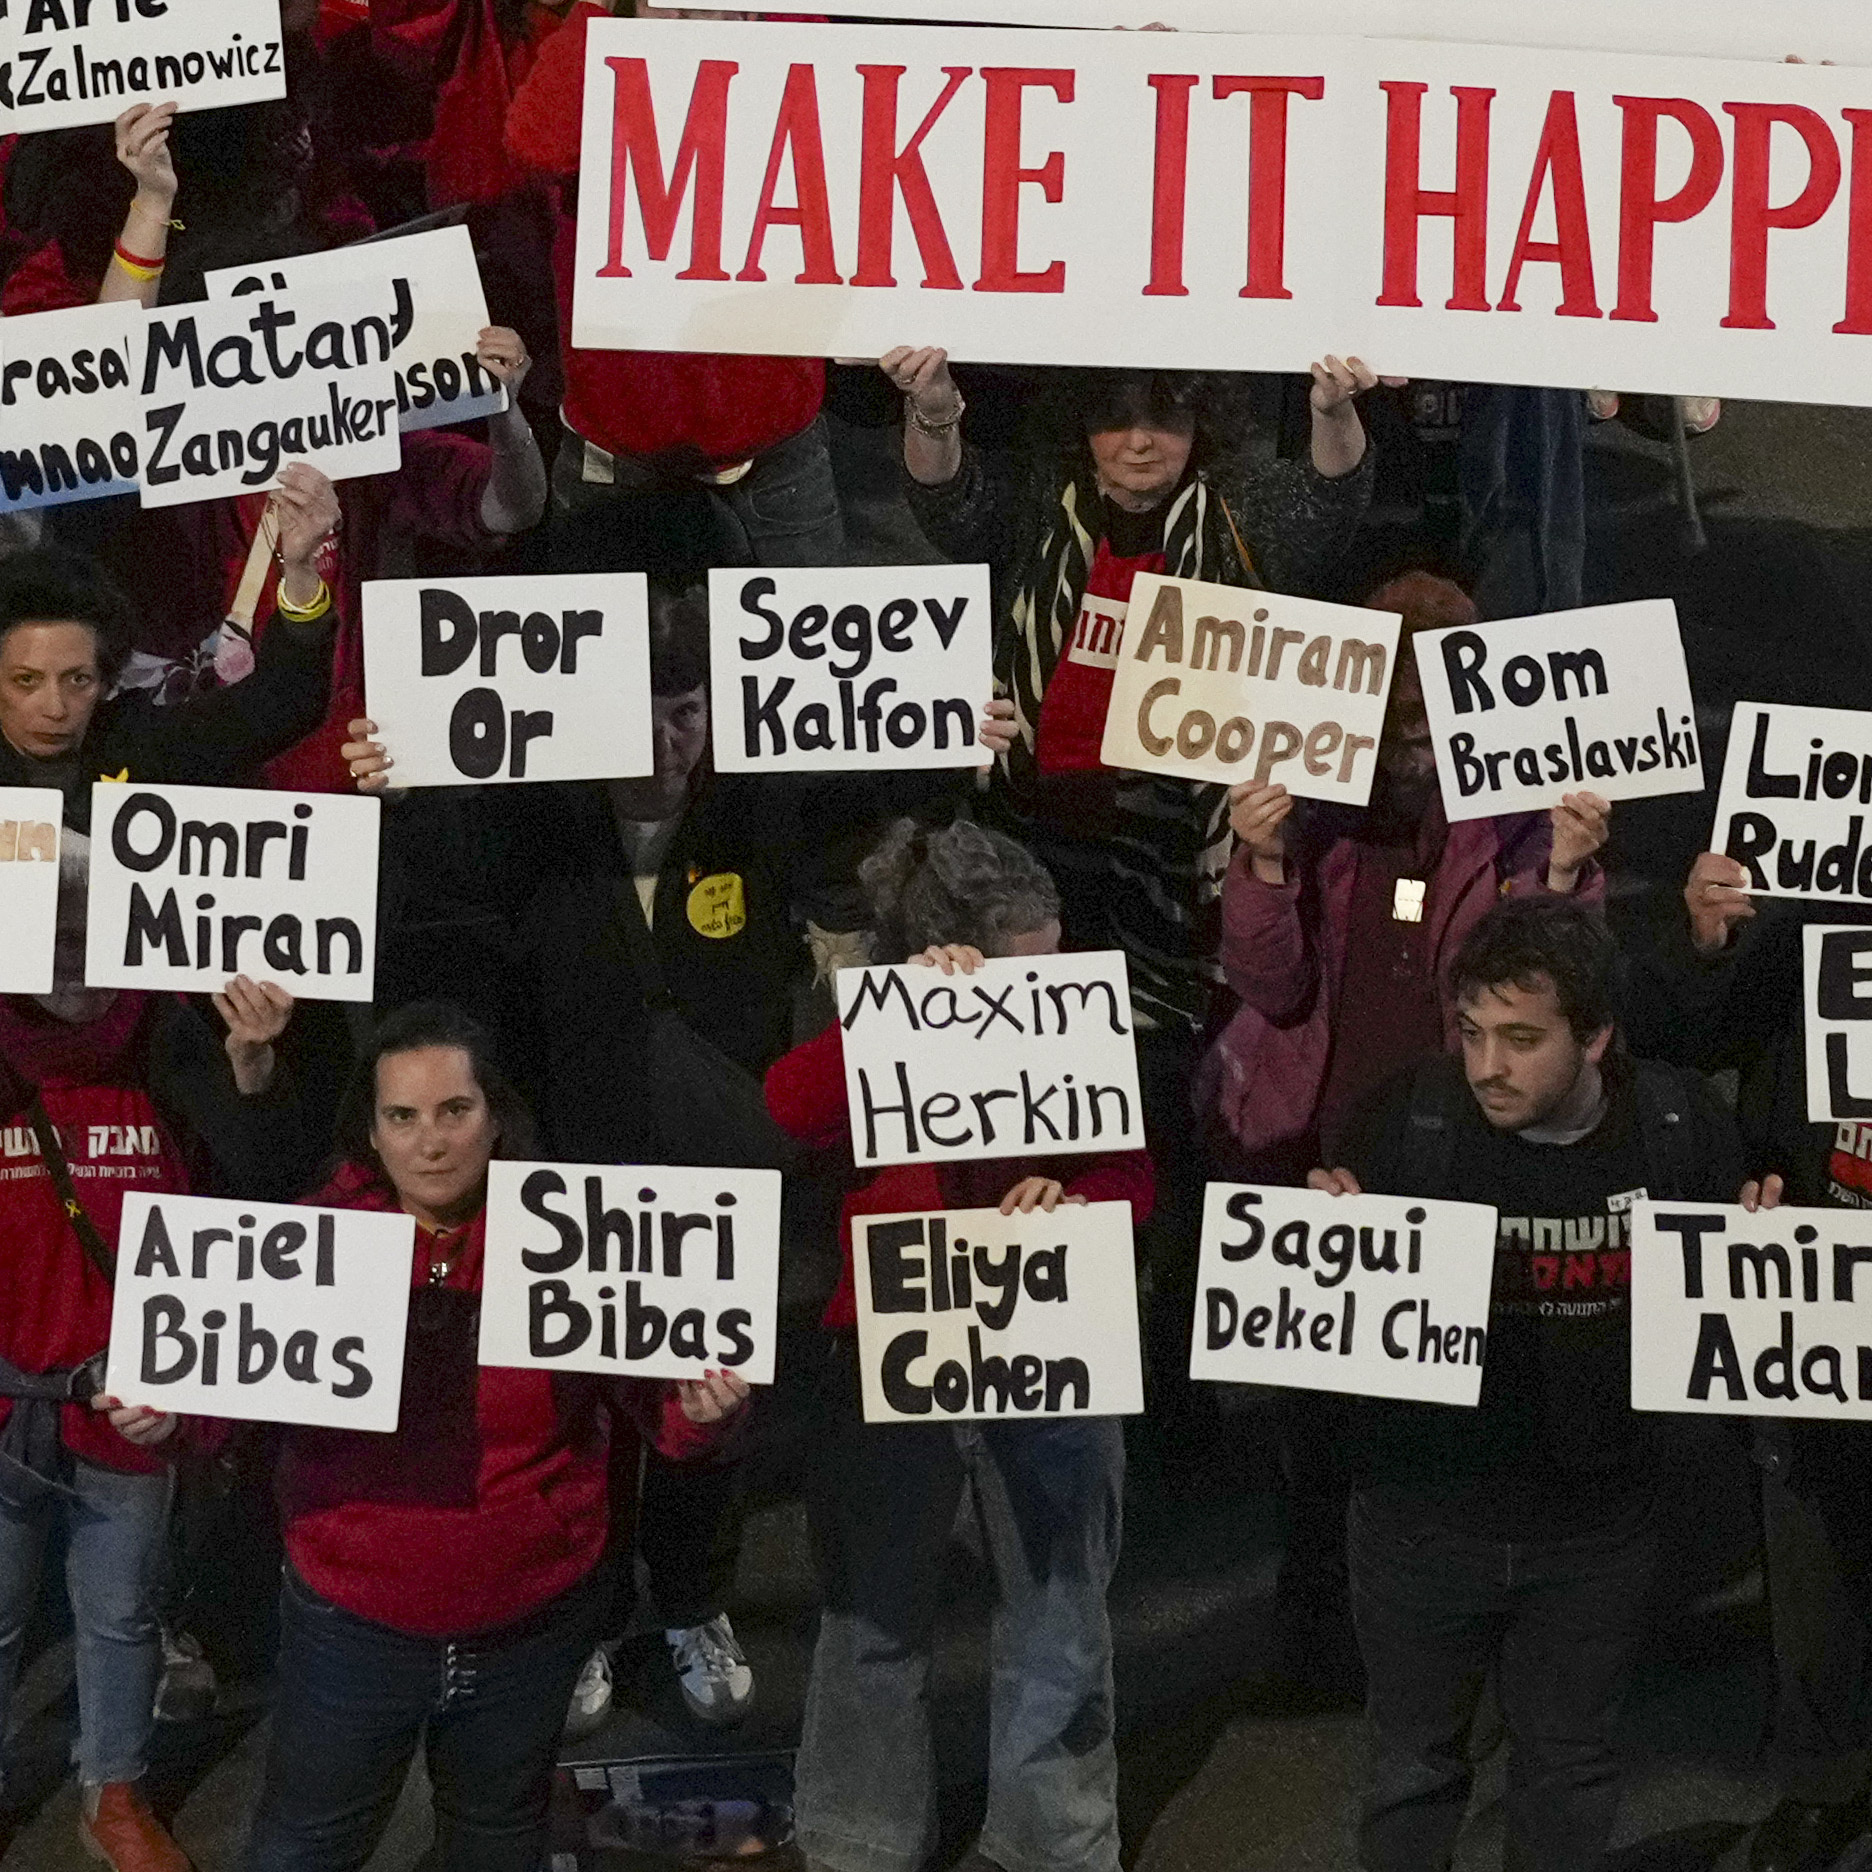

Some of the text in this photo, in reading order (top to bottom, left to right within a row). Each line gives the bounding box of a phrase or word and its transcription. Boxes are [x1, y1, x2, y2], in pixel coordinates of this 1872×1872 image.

[595, 54, 1077, 296] MAKE
[1140, 70, 1325, 300] IT
[140, 295, 394, 398] Matan
[142, 383, 398, 487] Zangauker
[418, 587, 606, 679] Dror
[738, 576, 971, 680] Segev
[1133, 585, 1390, 698] Amiram
[1438, 629, 1610, 716] Rom
[447, 686, 554, 781] Or
[740, 674, 976, 760] Kalfon
[1138, 676, 1375, 786] Cooper
[111, 791, 313, 882] Omri
[122, 881, 365, 978] Miran
[841, 969, 1132, 1041] Maxim
[857, 1060, 1131, 1160] Herkin
[131, 1204, 337, 1289] Ariel
[519, 1169, 738, 1283] Shiri
[1219, 1190, 1428, 1288] Sagui
[139, 1292, 375, 1400] Bibas
[527, 1279, 754, 1367] Bibas
[1380, 1299, 1486, 1367] Chen
[878, 1327, 1091, 1418] Cohen
